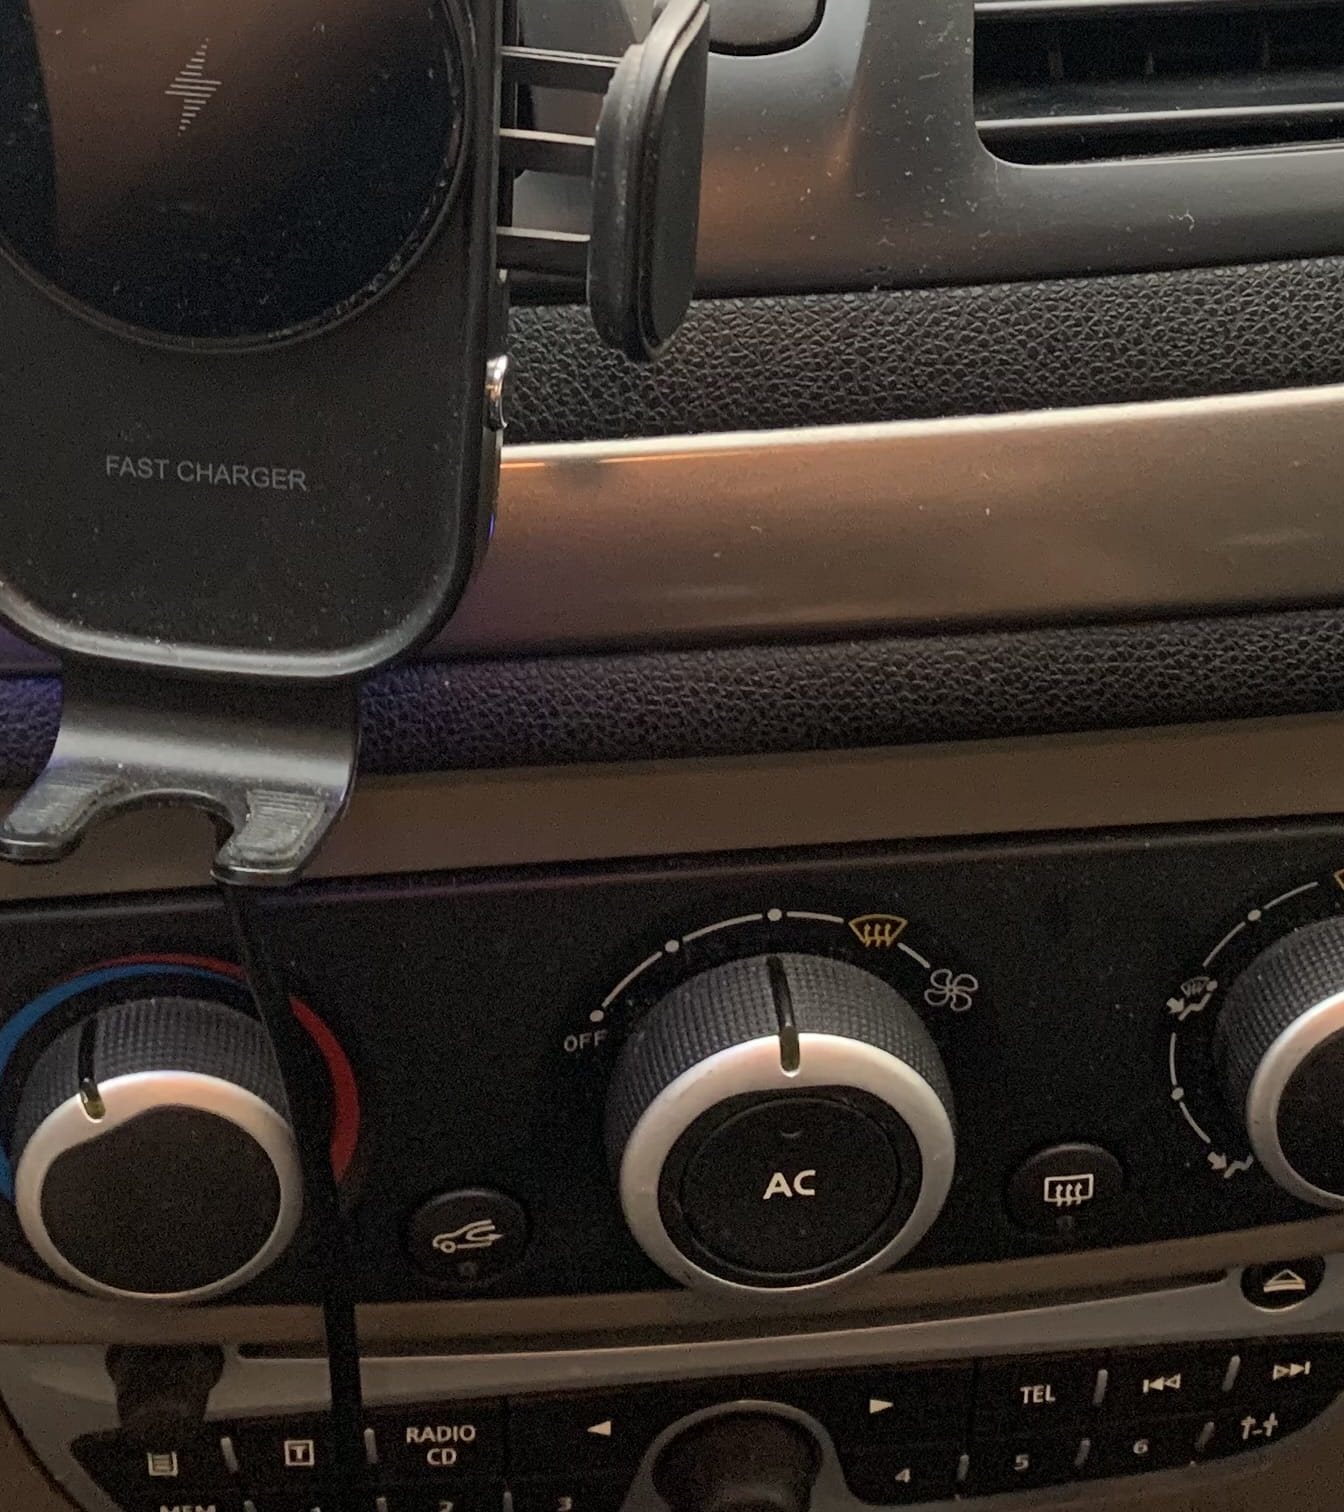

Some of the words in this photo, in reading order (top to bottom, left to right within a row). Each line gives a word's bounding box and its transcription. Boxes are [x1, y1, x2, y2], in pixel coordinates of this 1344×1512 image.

[106, 455, 169, 481] FAST
[177, 461, 307, 490] CHARGER
[563, 1029, 606, 1053] OFF
[763, 1170, 816, 1200] AC
[1020, 1384, 1056, 1404] TEL
[406, 1424, 476, 1443] RADIO
[426, 1448, 457, 1465] CD
[1133, 1439, 1149, 1455] 6
[1015, 1454, 1030, 1471] 5
[895, 1468, 911, 1484] 4
